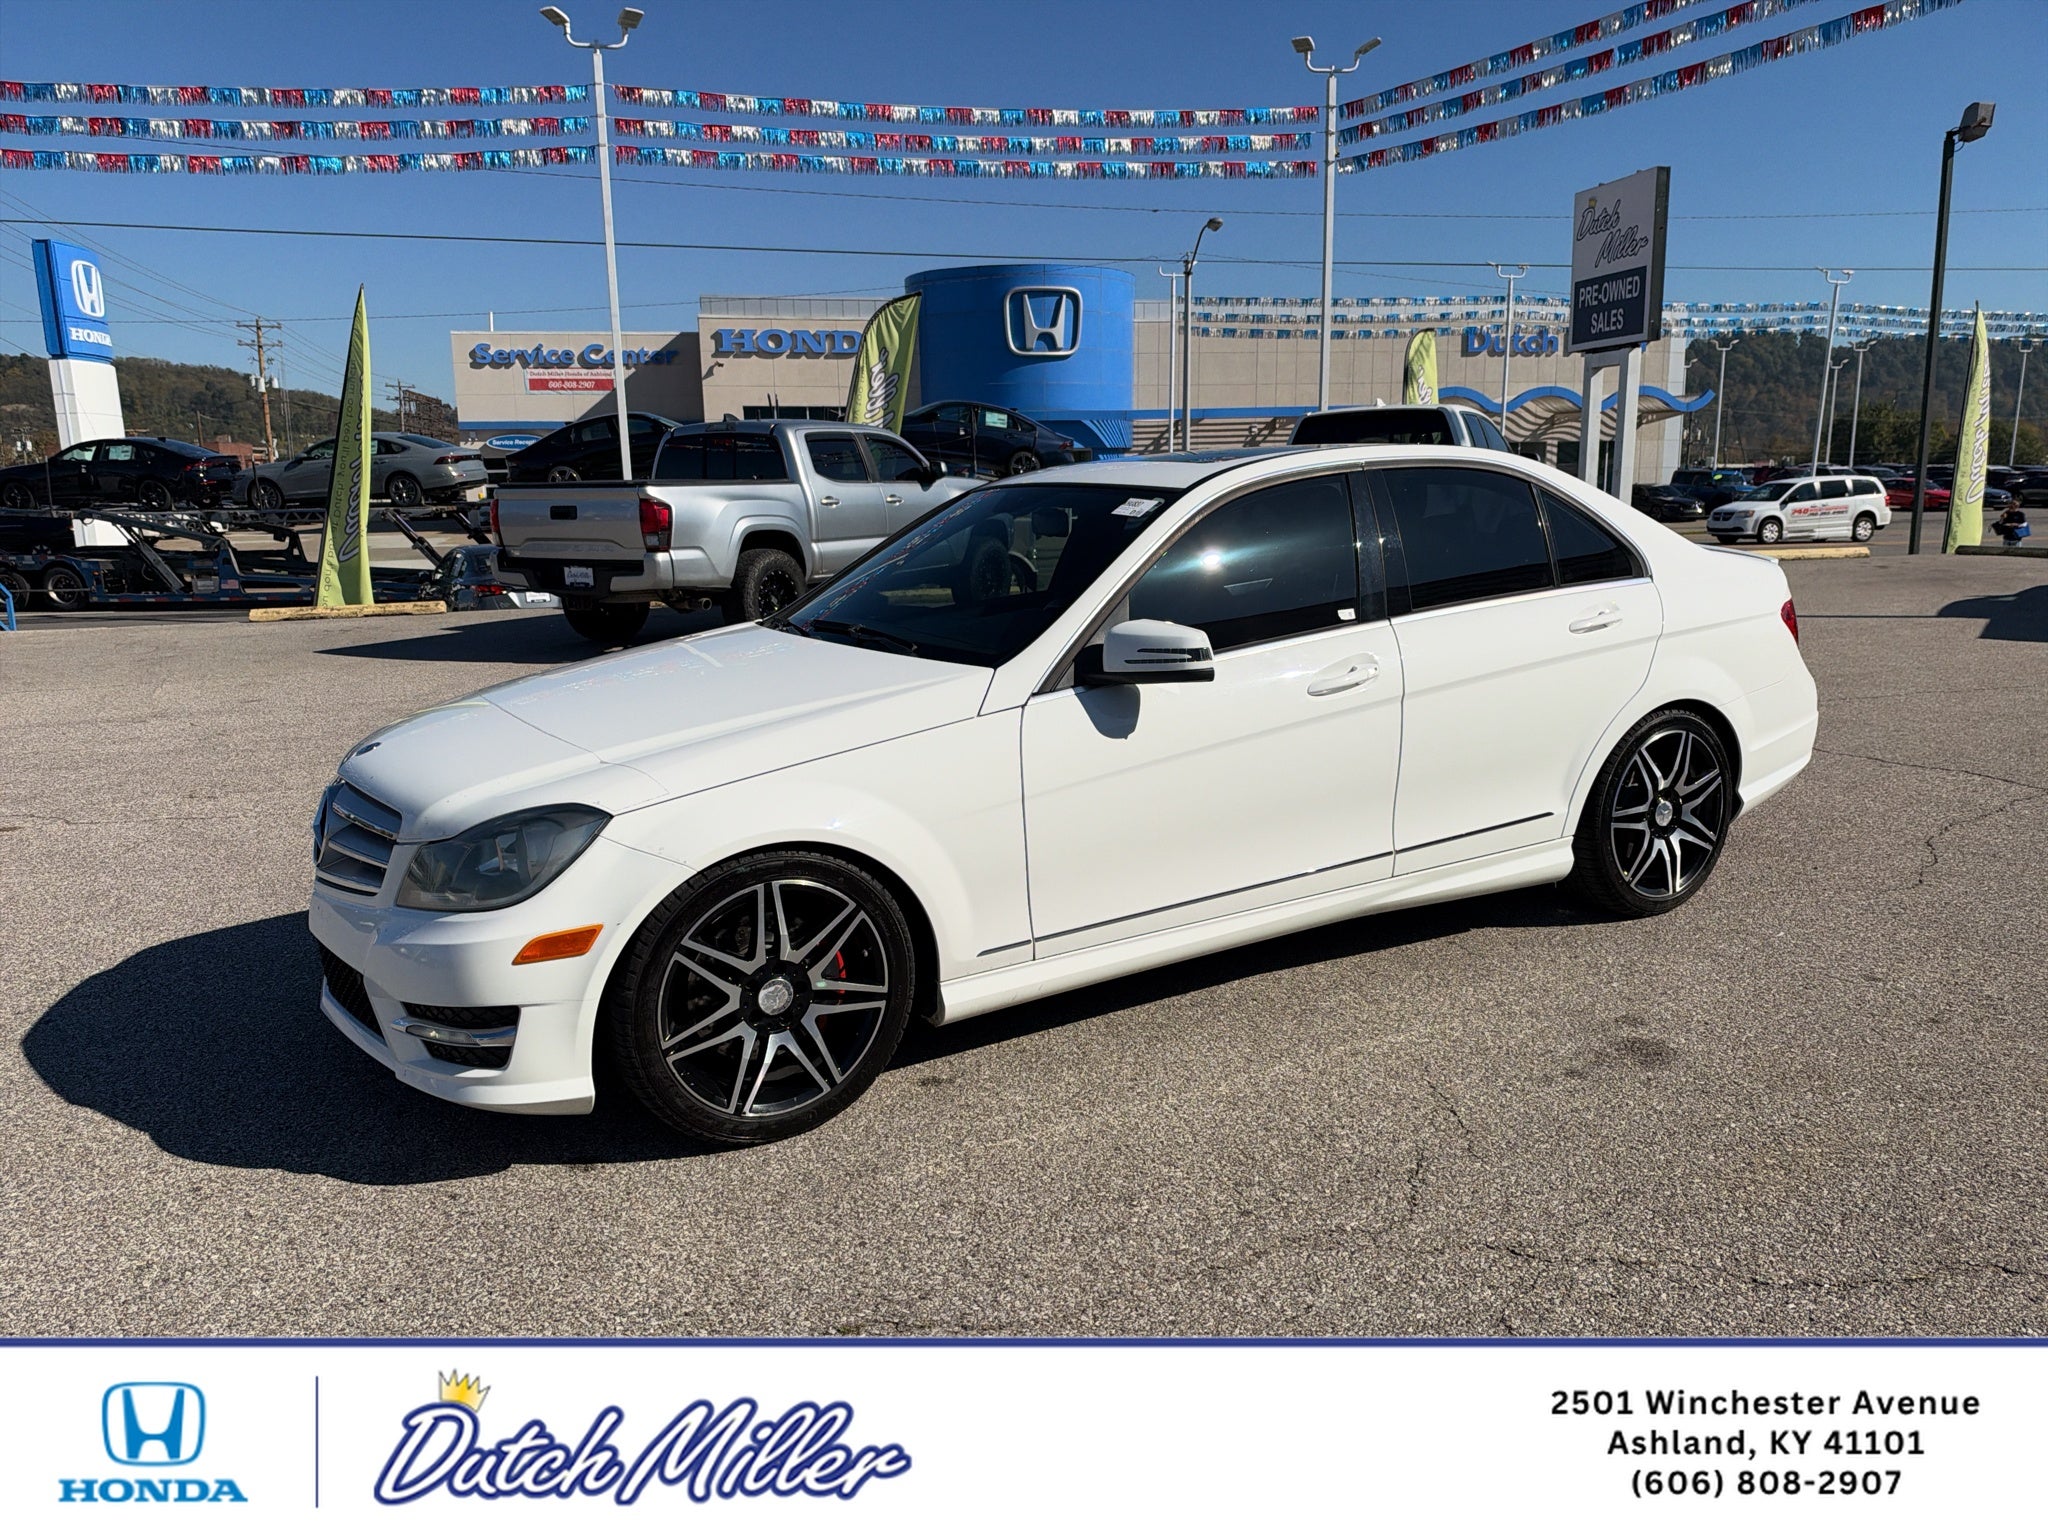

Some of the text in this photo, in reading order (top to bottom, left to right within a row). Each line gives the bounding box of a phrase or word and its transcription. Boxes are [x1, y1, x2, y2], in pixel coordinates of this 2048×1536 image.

[1576, 199, 1620, 241] Dutch
[1595, 225, 1649, 268] Miller
[1578, 275, 1640, 309] PRE-OWNED
[1590, 308, 1624, 335] SALES
[474, 343, 678, 365] Service Center
[718, 329, 864, 354] HOND
[548, 381, 595, 389] 606-808-2907
